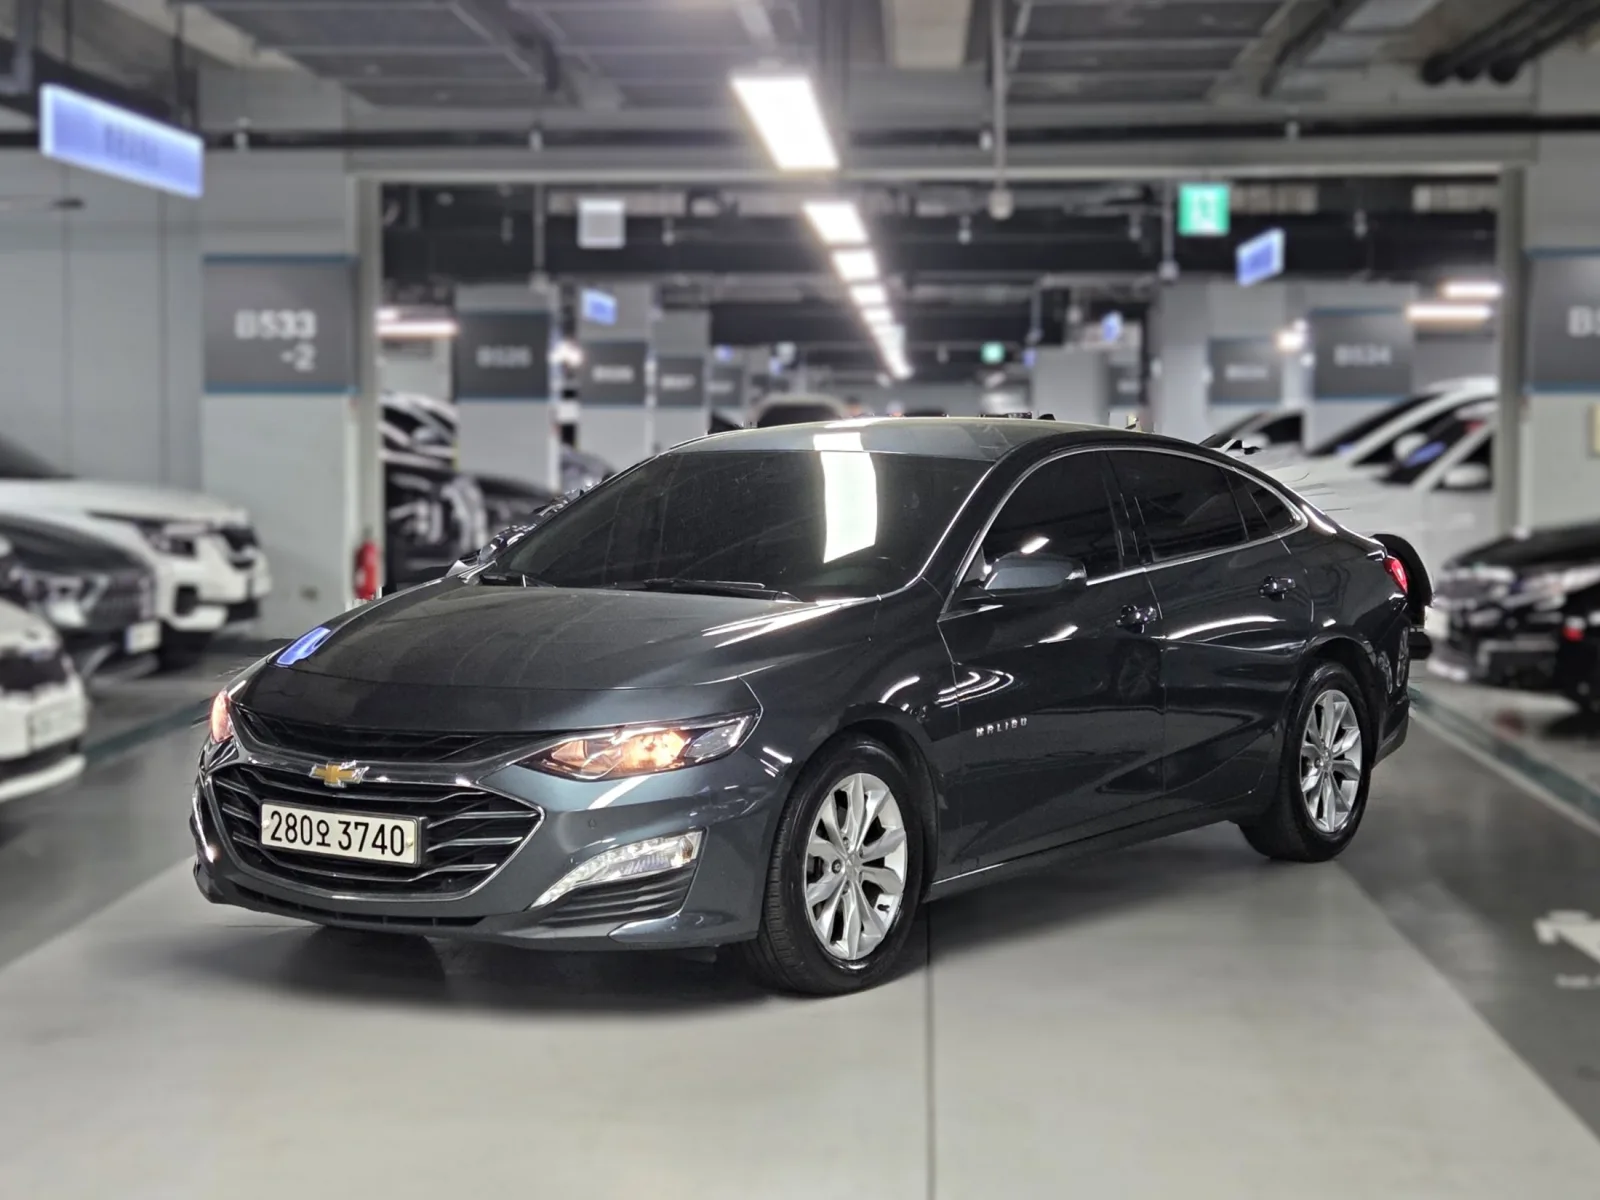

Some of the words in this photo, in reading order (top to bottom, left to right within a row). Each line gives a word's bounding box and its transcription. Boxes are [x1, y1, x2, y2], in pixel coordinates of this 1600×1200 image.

[280, 342, 317, 372] -2
[975, 716, 1028, 738] MALIBU
[270, 810, 331, 847] 280오
[337, 819, 405, 857] 3740
